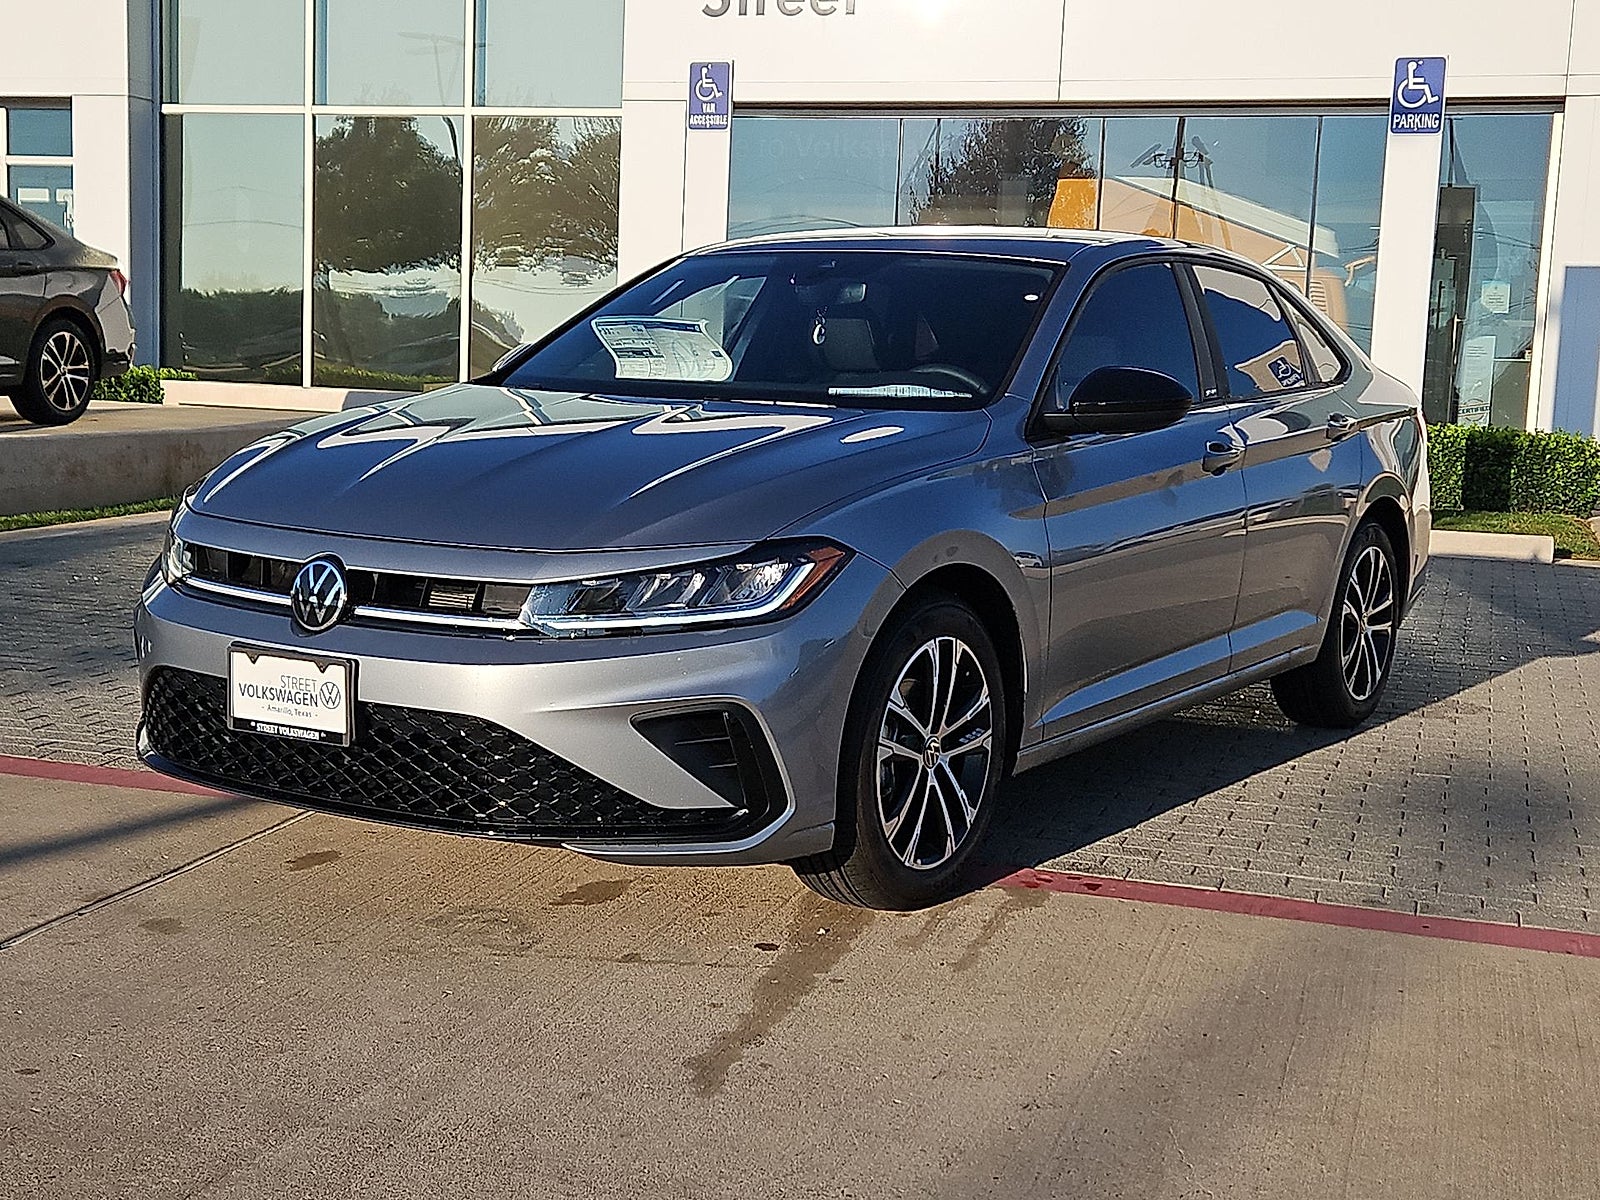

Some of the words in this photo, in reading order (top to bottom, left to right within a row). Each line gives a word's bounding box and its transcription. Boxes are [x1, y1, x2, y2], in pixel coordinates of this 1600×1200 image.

[690, 114, 728, 126] ACCESSIBLE
[1392, 113, 1440, 129] PARKING
[280, 675, 317, 692] STREET
[238, 682, 319, 708] VOLKSWAGEN
[294, 708, 312, 718] Texas
